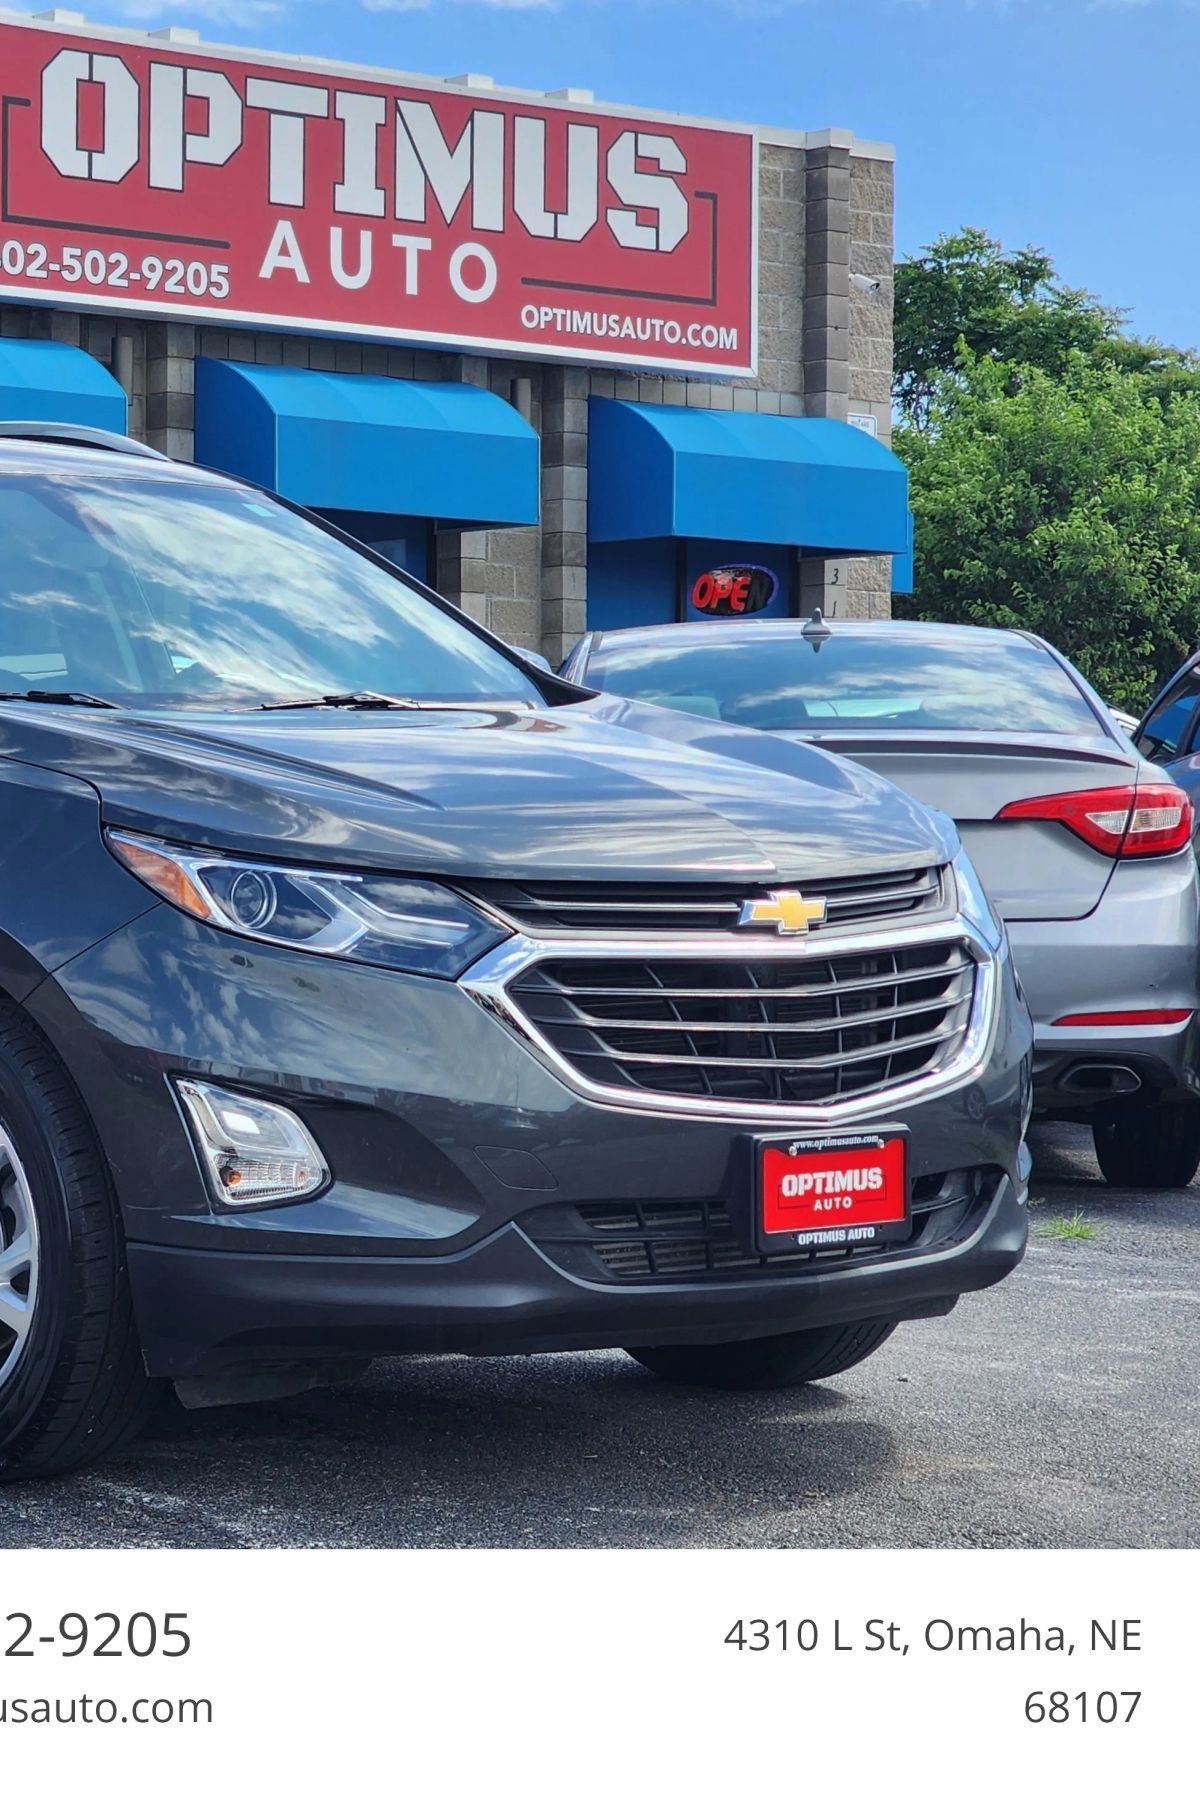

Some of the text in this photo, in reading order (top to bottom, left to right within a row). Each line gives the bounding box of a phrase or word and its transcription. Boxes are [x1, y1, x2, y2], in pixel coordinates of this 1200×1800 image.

[39, 48, 690, 253] OPTIMUS
[259, 220, 498, 303] AUTO
[520, 304, 738, 351] OPTIMUSAUTO.COM
[691, 572, 771, 612] OPEN
[781, 1167, 883, 1197] OPTIMUS
[813, 1197, 853, 1211] AUTO
[798, 1226, 875, 1245] OPTIMUS AUTO
